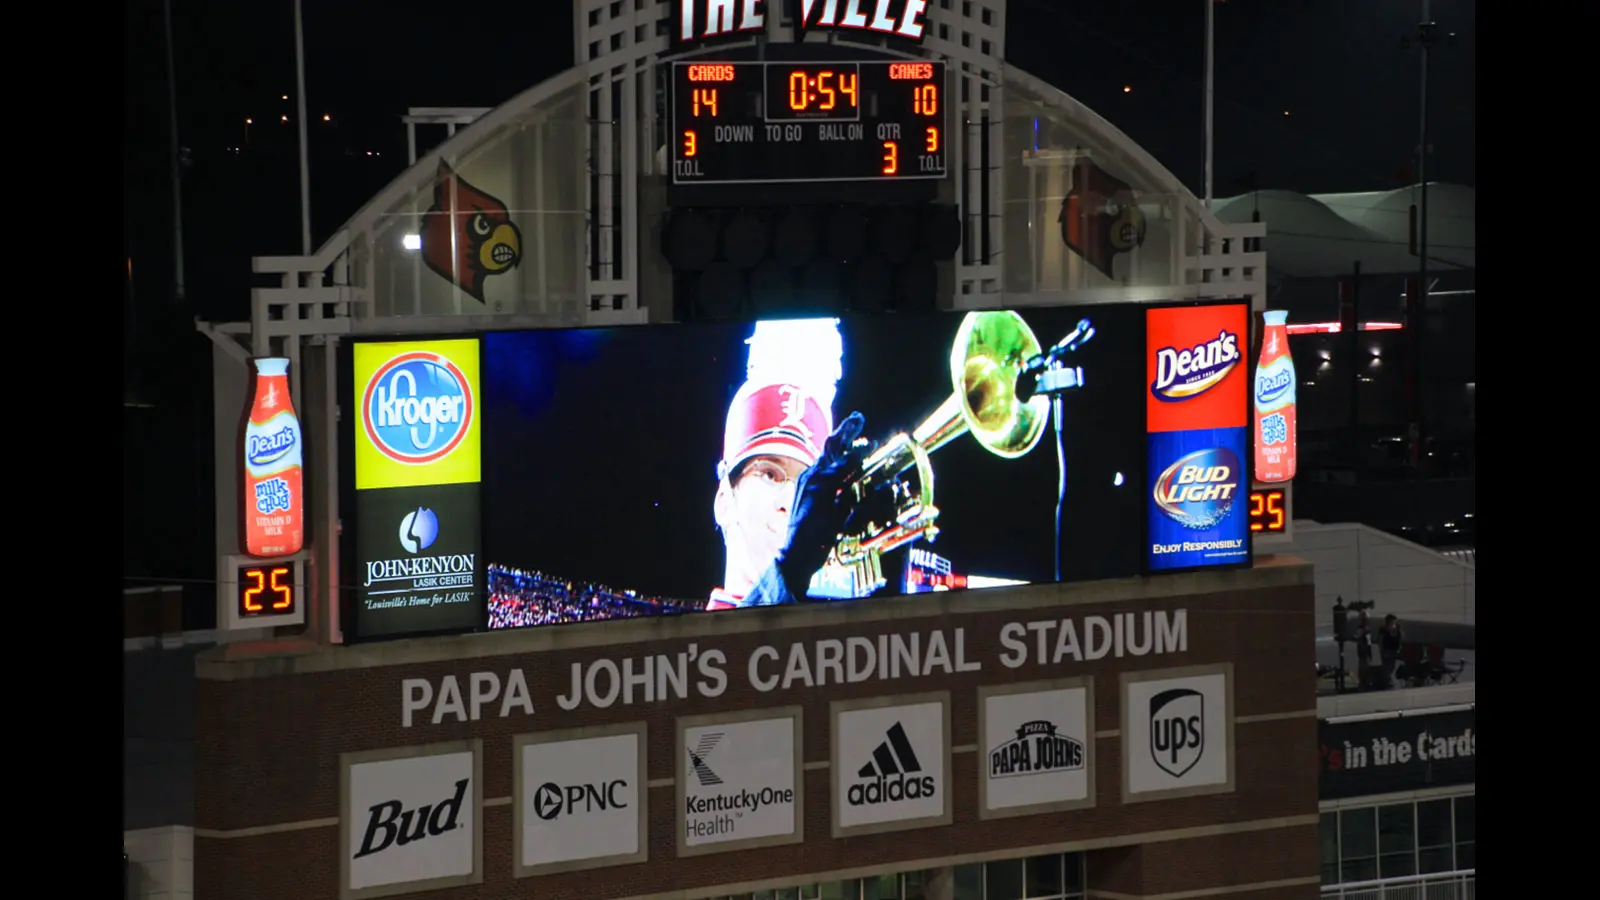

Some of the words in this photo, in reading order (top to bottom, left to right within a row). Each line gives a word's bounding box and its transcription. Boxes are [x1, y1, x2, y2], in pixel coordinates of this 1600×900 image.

[801, 0, 926, 38] VILLE
[688, 64, 735, 82] CARDS
[888, 63, 934, 80] CANES
[692, 88, 718, 117] 14
[789, 71, 857, 110] 0:54
[913, 84, 937, 116] 10
[683, 130, 697, 157] 3
[715, 125, 754, 142] DOWN
[765, 125, 783, 142] TO
[785, 124, 802, 142] GO
[818, 123, 848, 141] BALL
[848, 123, 863, 141] ON
[877, 122, 901, 141] QTR
[926, 127, 938, 152] 3
[675, 159, 705, 177] T.O.L.
[882, 141, 898, 174] 3
[918, 155, 945, 172] T.O.L.
[1156, 331, 1237, 390] Dean's
[1257, 368, 1291, 397] Dean's
[377, 369, 463, 449] Kroger
[249, 426, 296, 458] Dean's
[1178, 465, 1230, 485] BUD
[1166, 483, 1237, 504] LIGHT
[1250, 492, 1284, 531] 25
[363, 554, 475, 587] JOHN-KENYON
[909, 548, 937, 570] VILLE
[244, 568, 291, 611] 25
[413, 578, 439, 588] LASIK
[440, 574, 473, 586] CENTER
[408, 595, 431, 607] Home
[430, 593, 443, 607] for
[402, 668, 535, 728] PAPA
[556, 643, 728, 710] JOHN'S
[748, 627, 981, 692] CARDINAL
[999, 608, 1188, 669] STADIUM
[1024, 723, 1049, 734] PIZZA
[1154, 715, 1201, 764] ups
[992, 739, 1032, 776] PAPA
[1033, 735, 1082, 770] JOHNS
[1344, 740, 1367, 769] in
[1372, 737, 1412, 766] the
[563, 779, 628, 815] PNC
[685, 786, 794, 814] KentuckyOne
[847, 774, 935, 806] adidas
[353, 777, 470, 860] Bud
